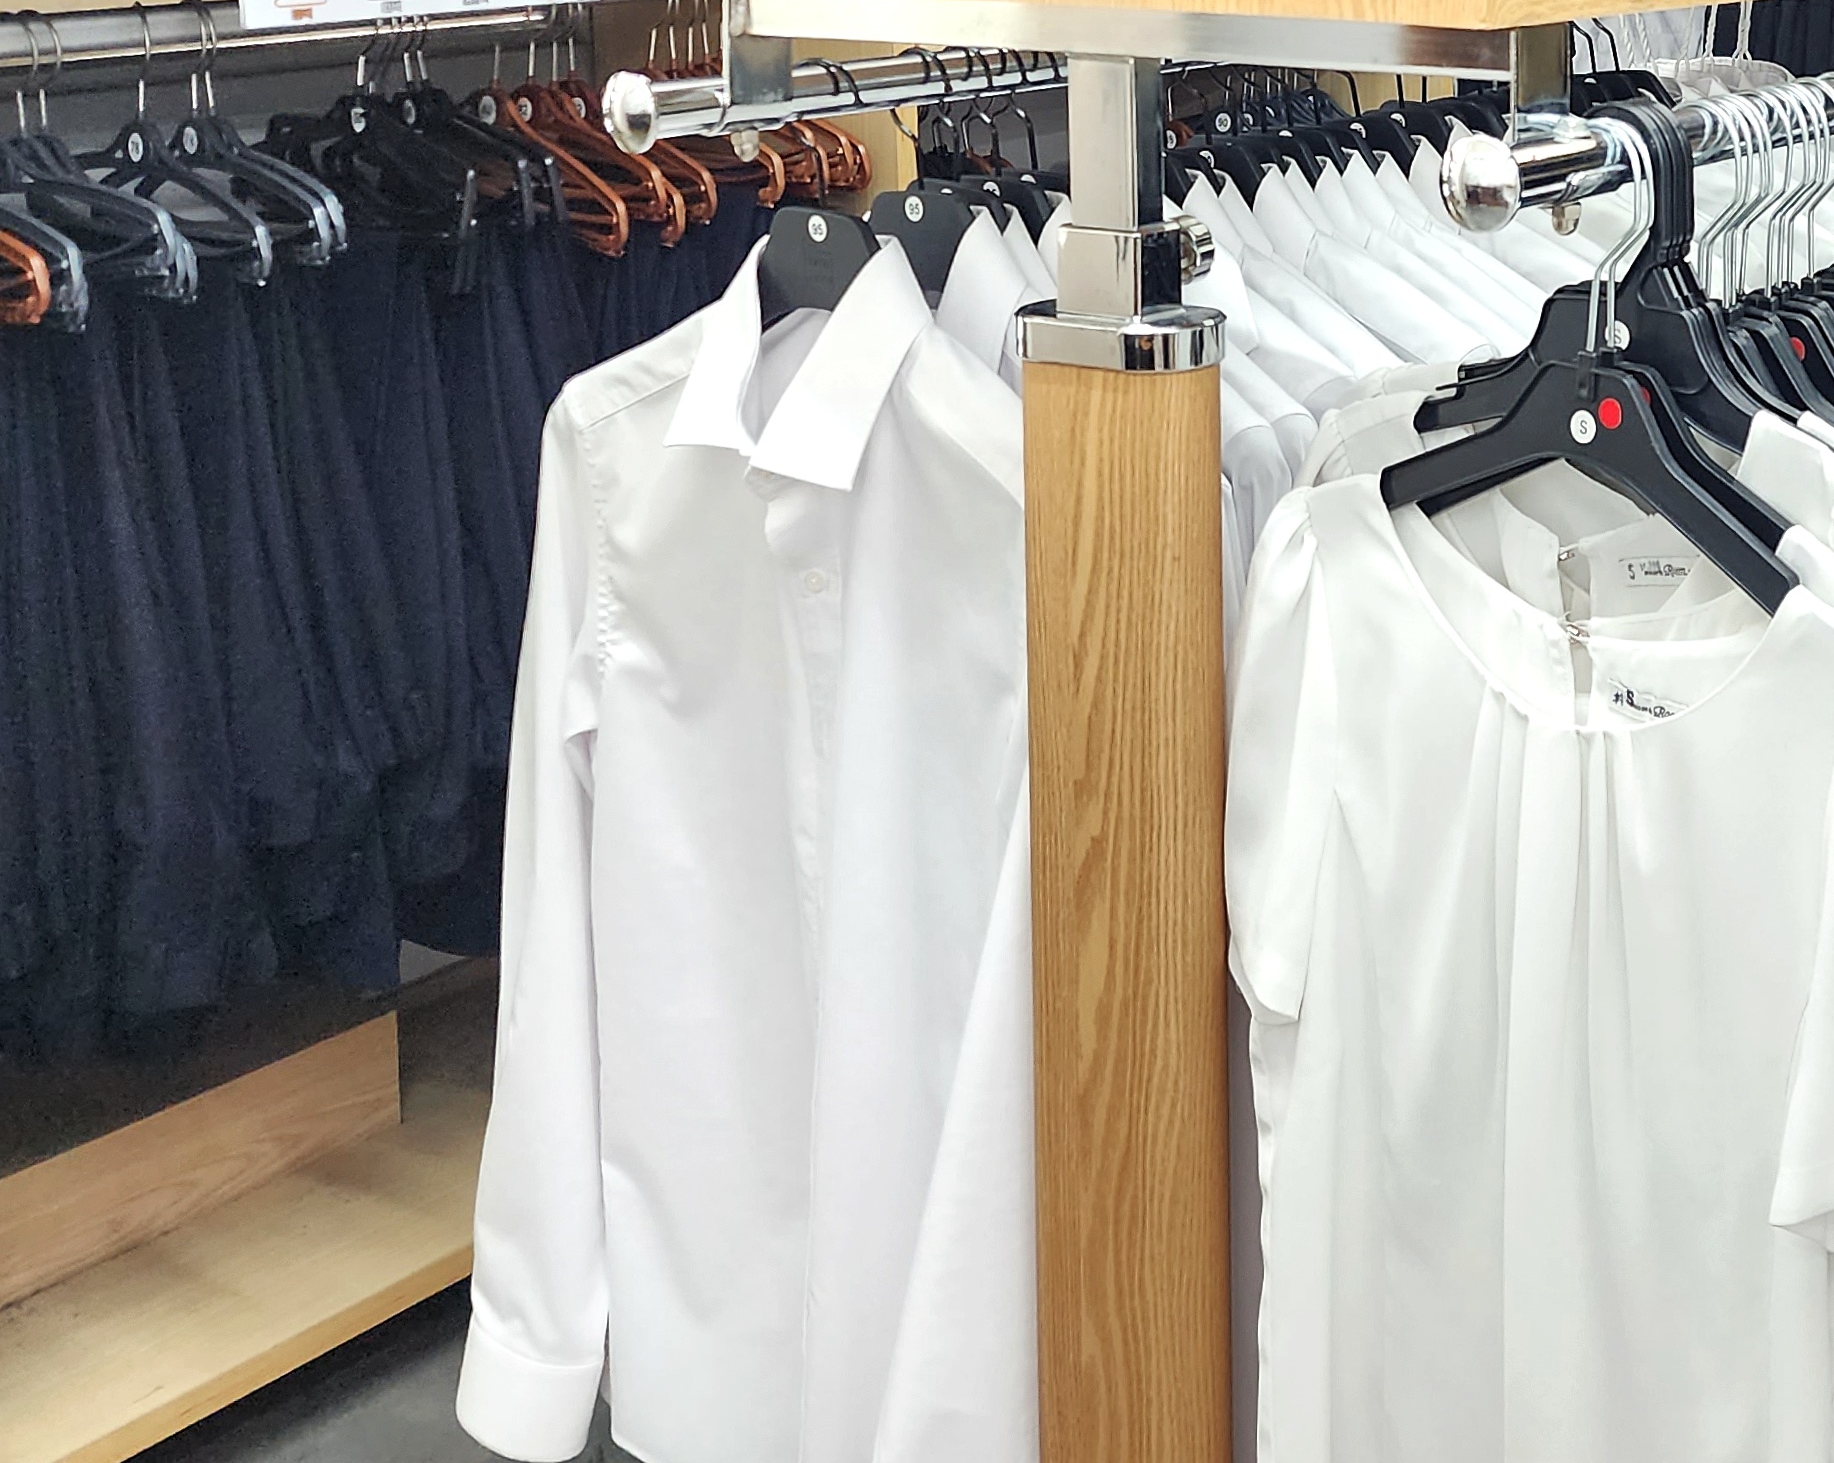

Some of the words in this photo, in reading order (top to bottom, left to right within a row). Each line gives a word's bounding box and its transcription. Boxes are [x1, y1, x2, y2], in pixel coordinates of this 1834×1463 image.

[909, 203, 920, 215] 95
[811, 223, 824, 236] 95
[1579, 420, 1588, 435] S
